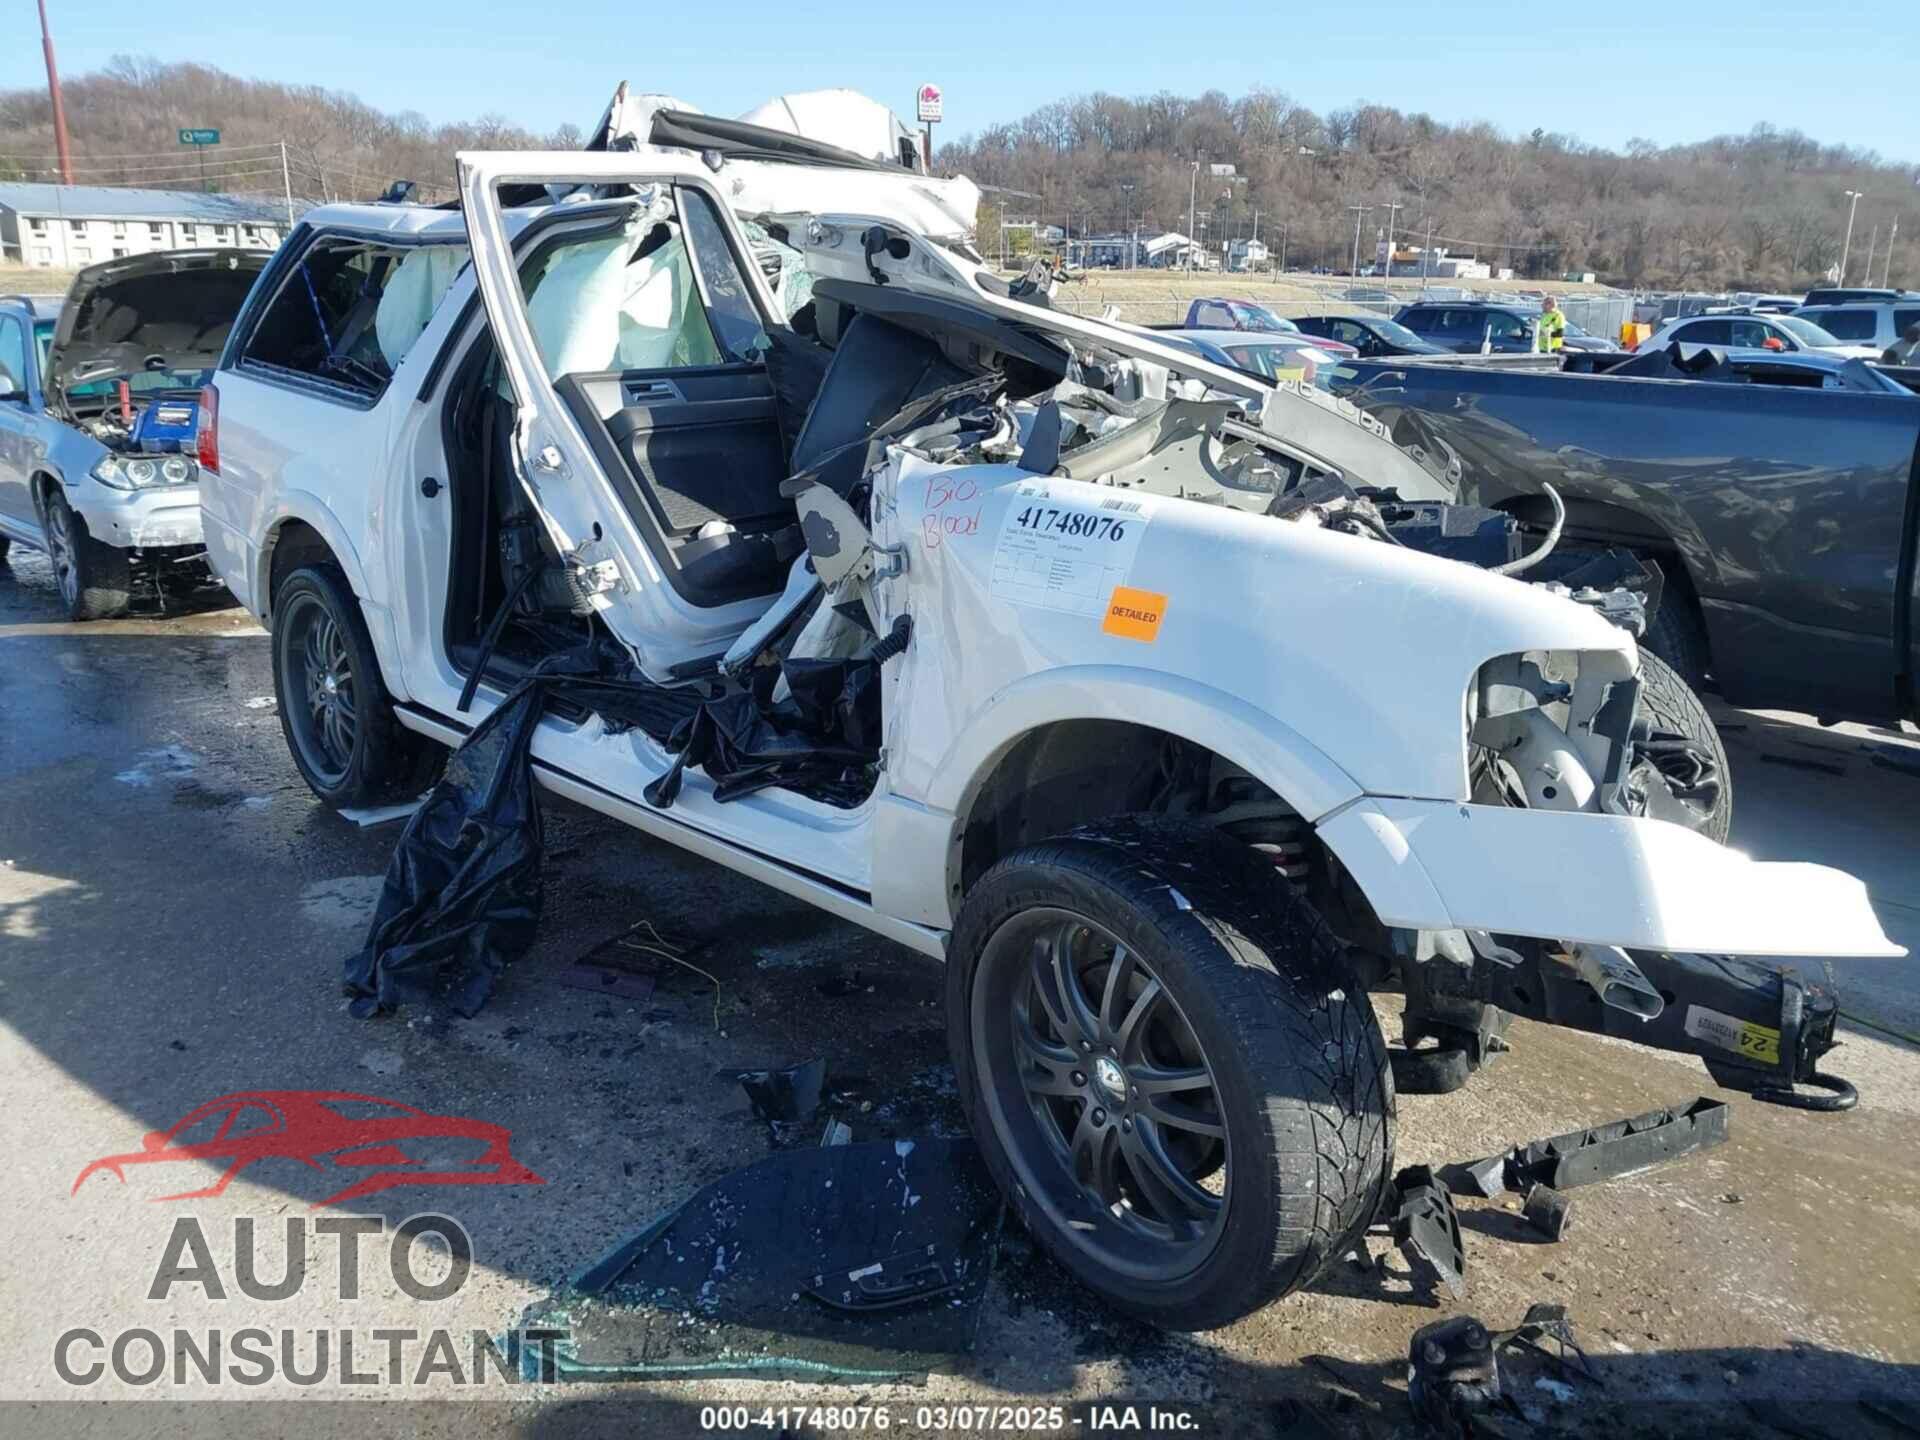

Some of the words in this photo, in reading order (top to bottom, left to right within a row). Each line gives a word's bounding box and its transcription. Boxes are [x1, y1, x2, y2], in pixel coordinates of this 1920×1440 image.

[1017, 506, 1125, 542] 41748076
[1112, 606, 1157, 623] DETAILED
[1741, 1032, 1768, 1052] 24
